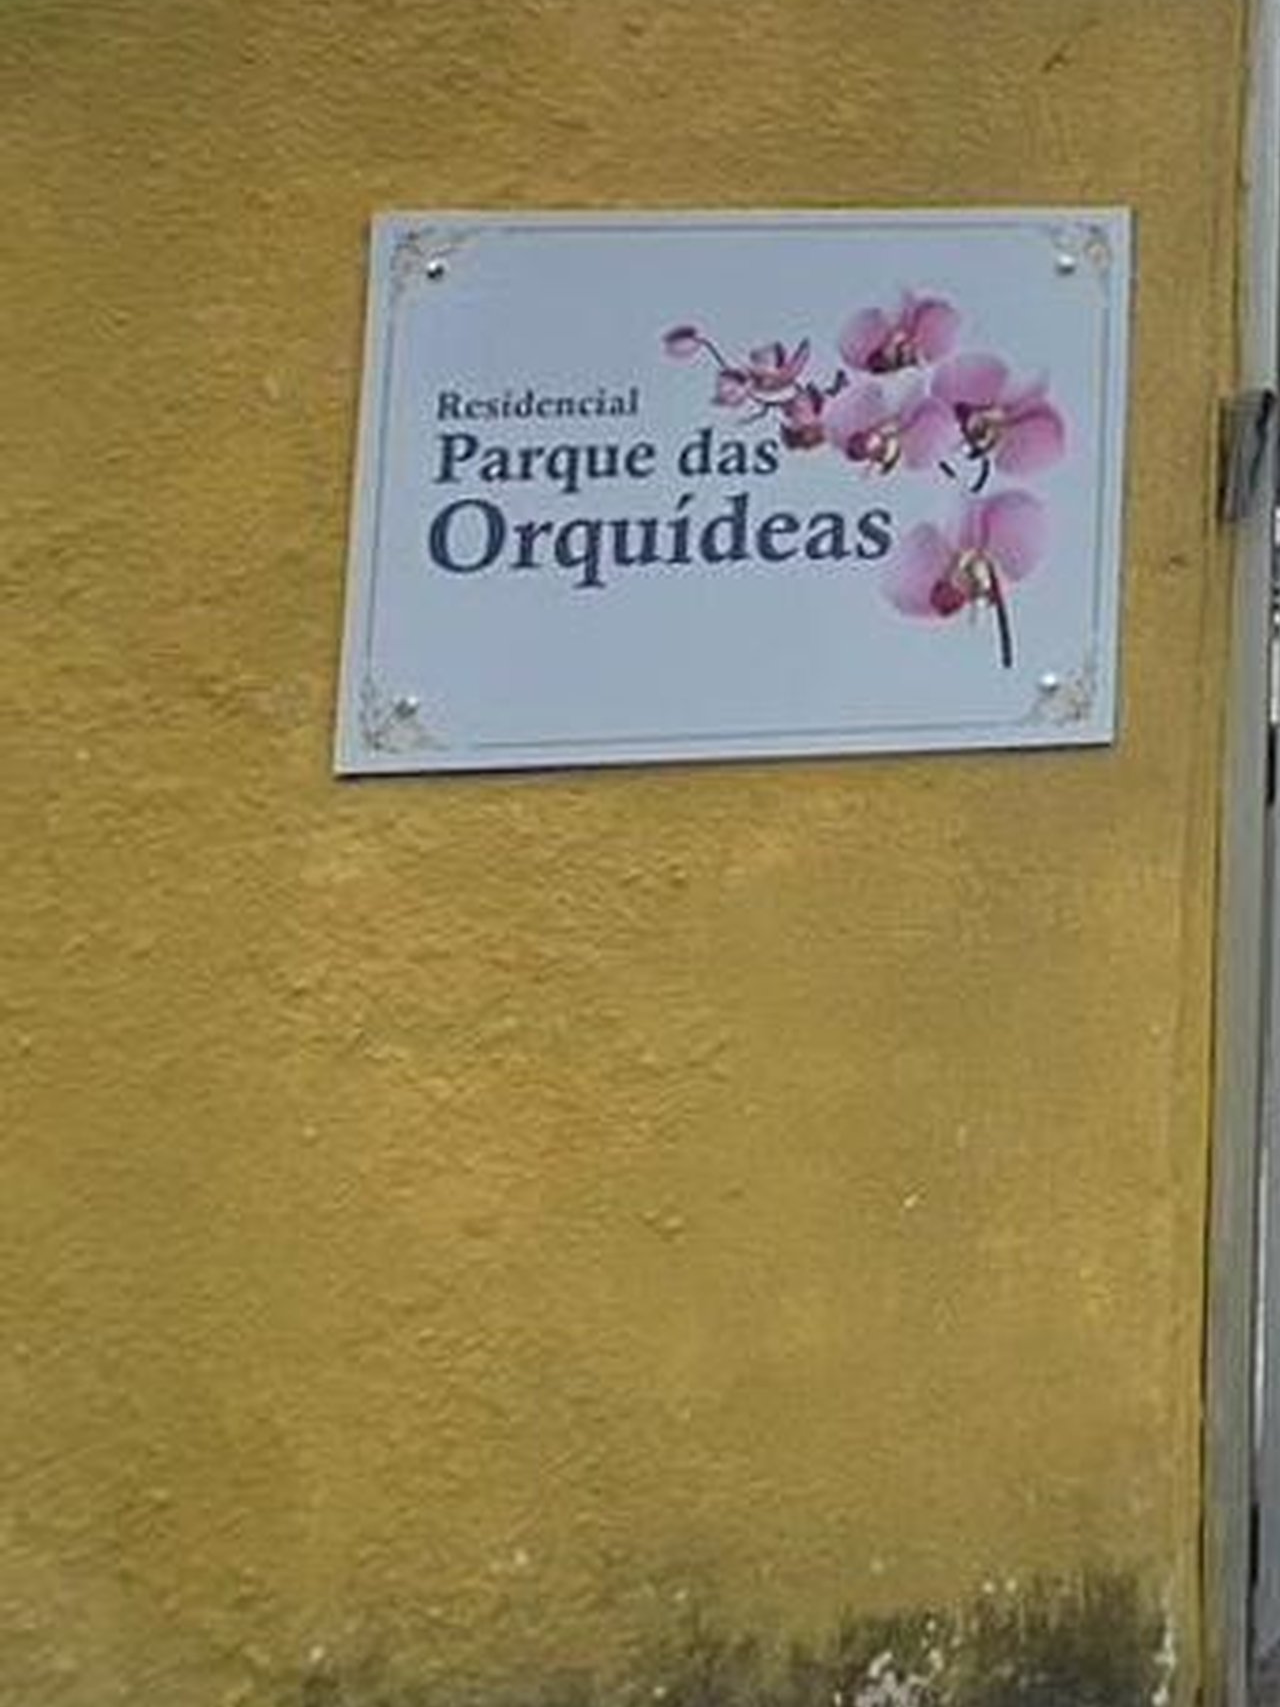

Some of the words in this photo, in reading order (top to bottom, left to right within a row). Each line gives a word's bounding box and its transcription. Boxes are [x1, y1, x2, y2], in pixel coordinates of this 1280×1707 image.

[436, 388, 639, 422] Residencial
[433, 431, 657, 495] Parque
[678, 428, 781, 478] das
[429, 491, 895, 589] Orquídeas
